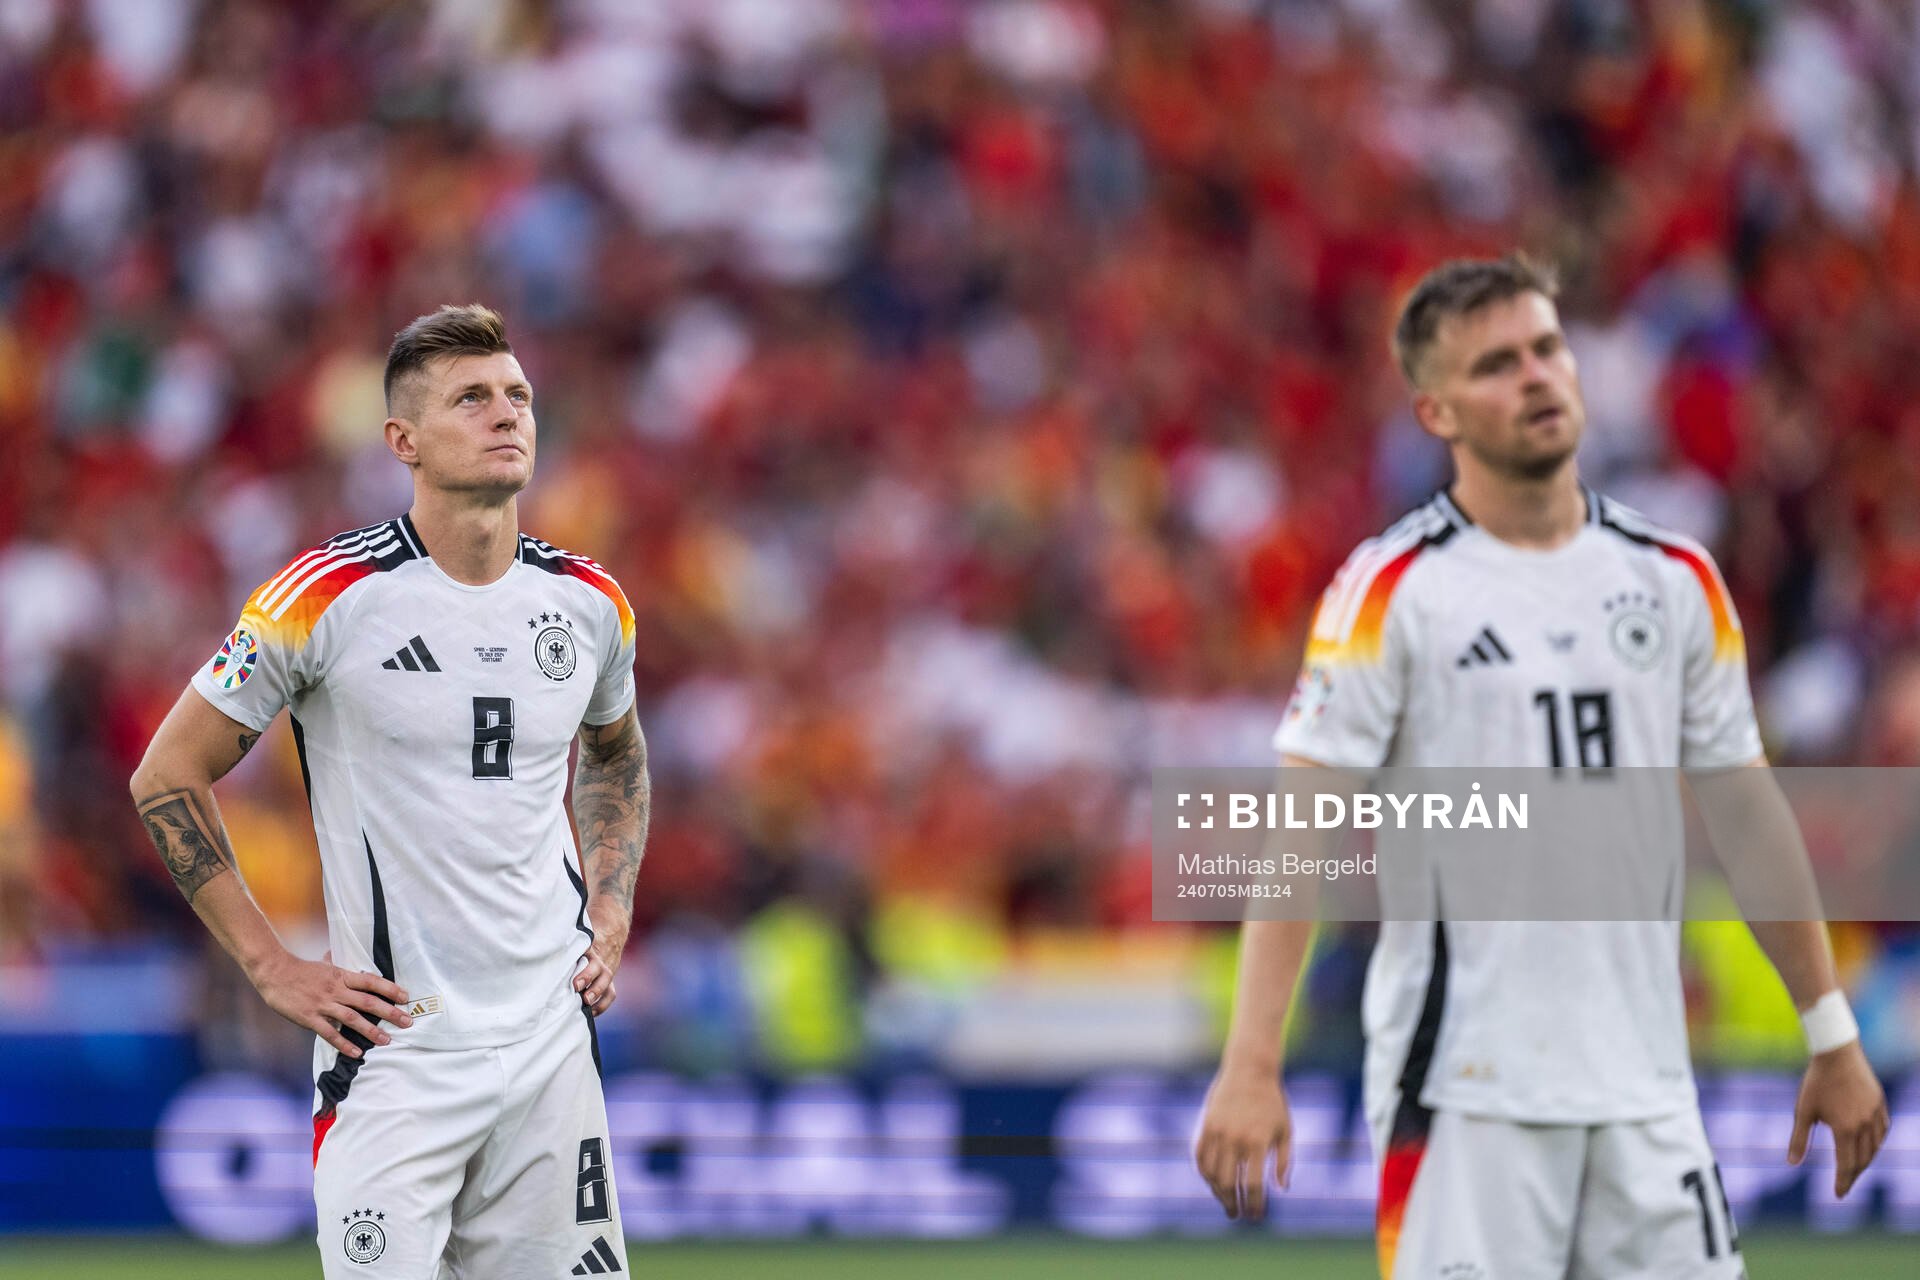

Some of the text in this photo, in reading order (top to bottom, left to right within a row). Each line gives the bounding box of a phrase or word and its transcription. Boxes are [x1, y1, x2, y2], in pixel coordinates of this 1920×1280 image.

[472, 696, 514, 780] 8
[1533, 688, 1615, 780] 18
[576, 1137, 612, 1225] 8
[1681, 1162, 1740, 1259] 1
